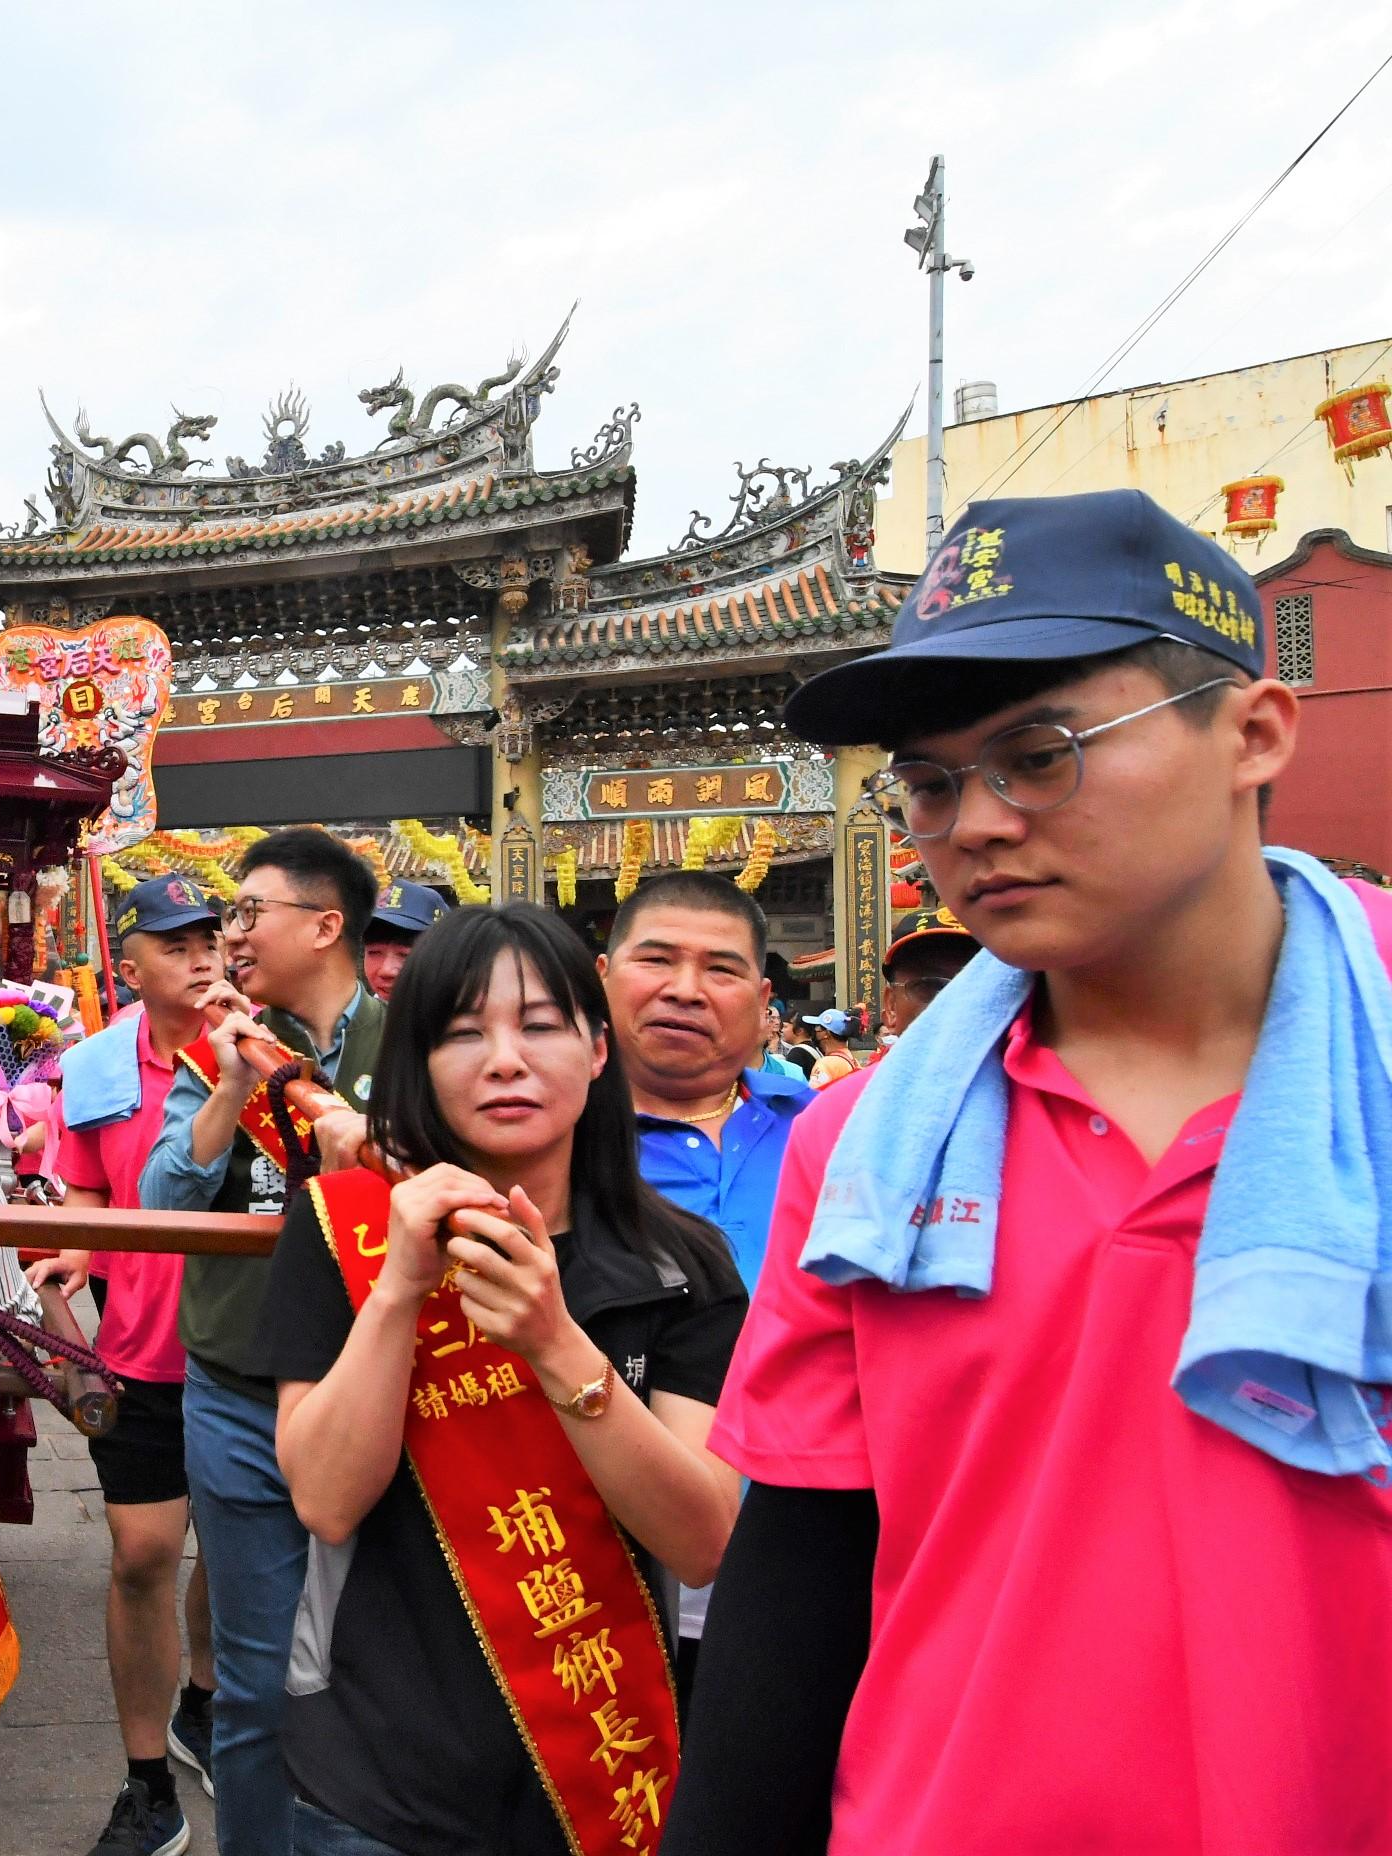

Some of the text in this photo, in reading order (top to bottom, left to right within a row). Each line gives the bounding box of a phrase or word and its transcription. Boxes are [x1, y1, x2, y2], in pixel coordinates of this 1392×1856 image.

[70, 685, 94, 713] 日
[600, 771, 775, 809] 風調雨順
[411, 1362, 527, 1421] 請媽祖
[486, 1486, 670, 1856] 埔鹽鄉長許
